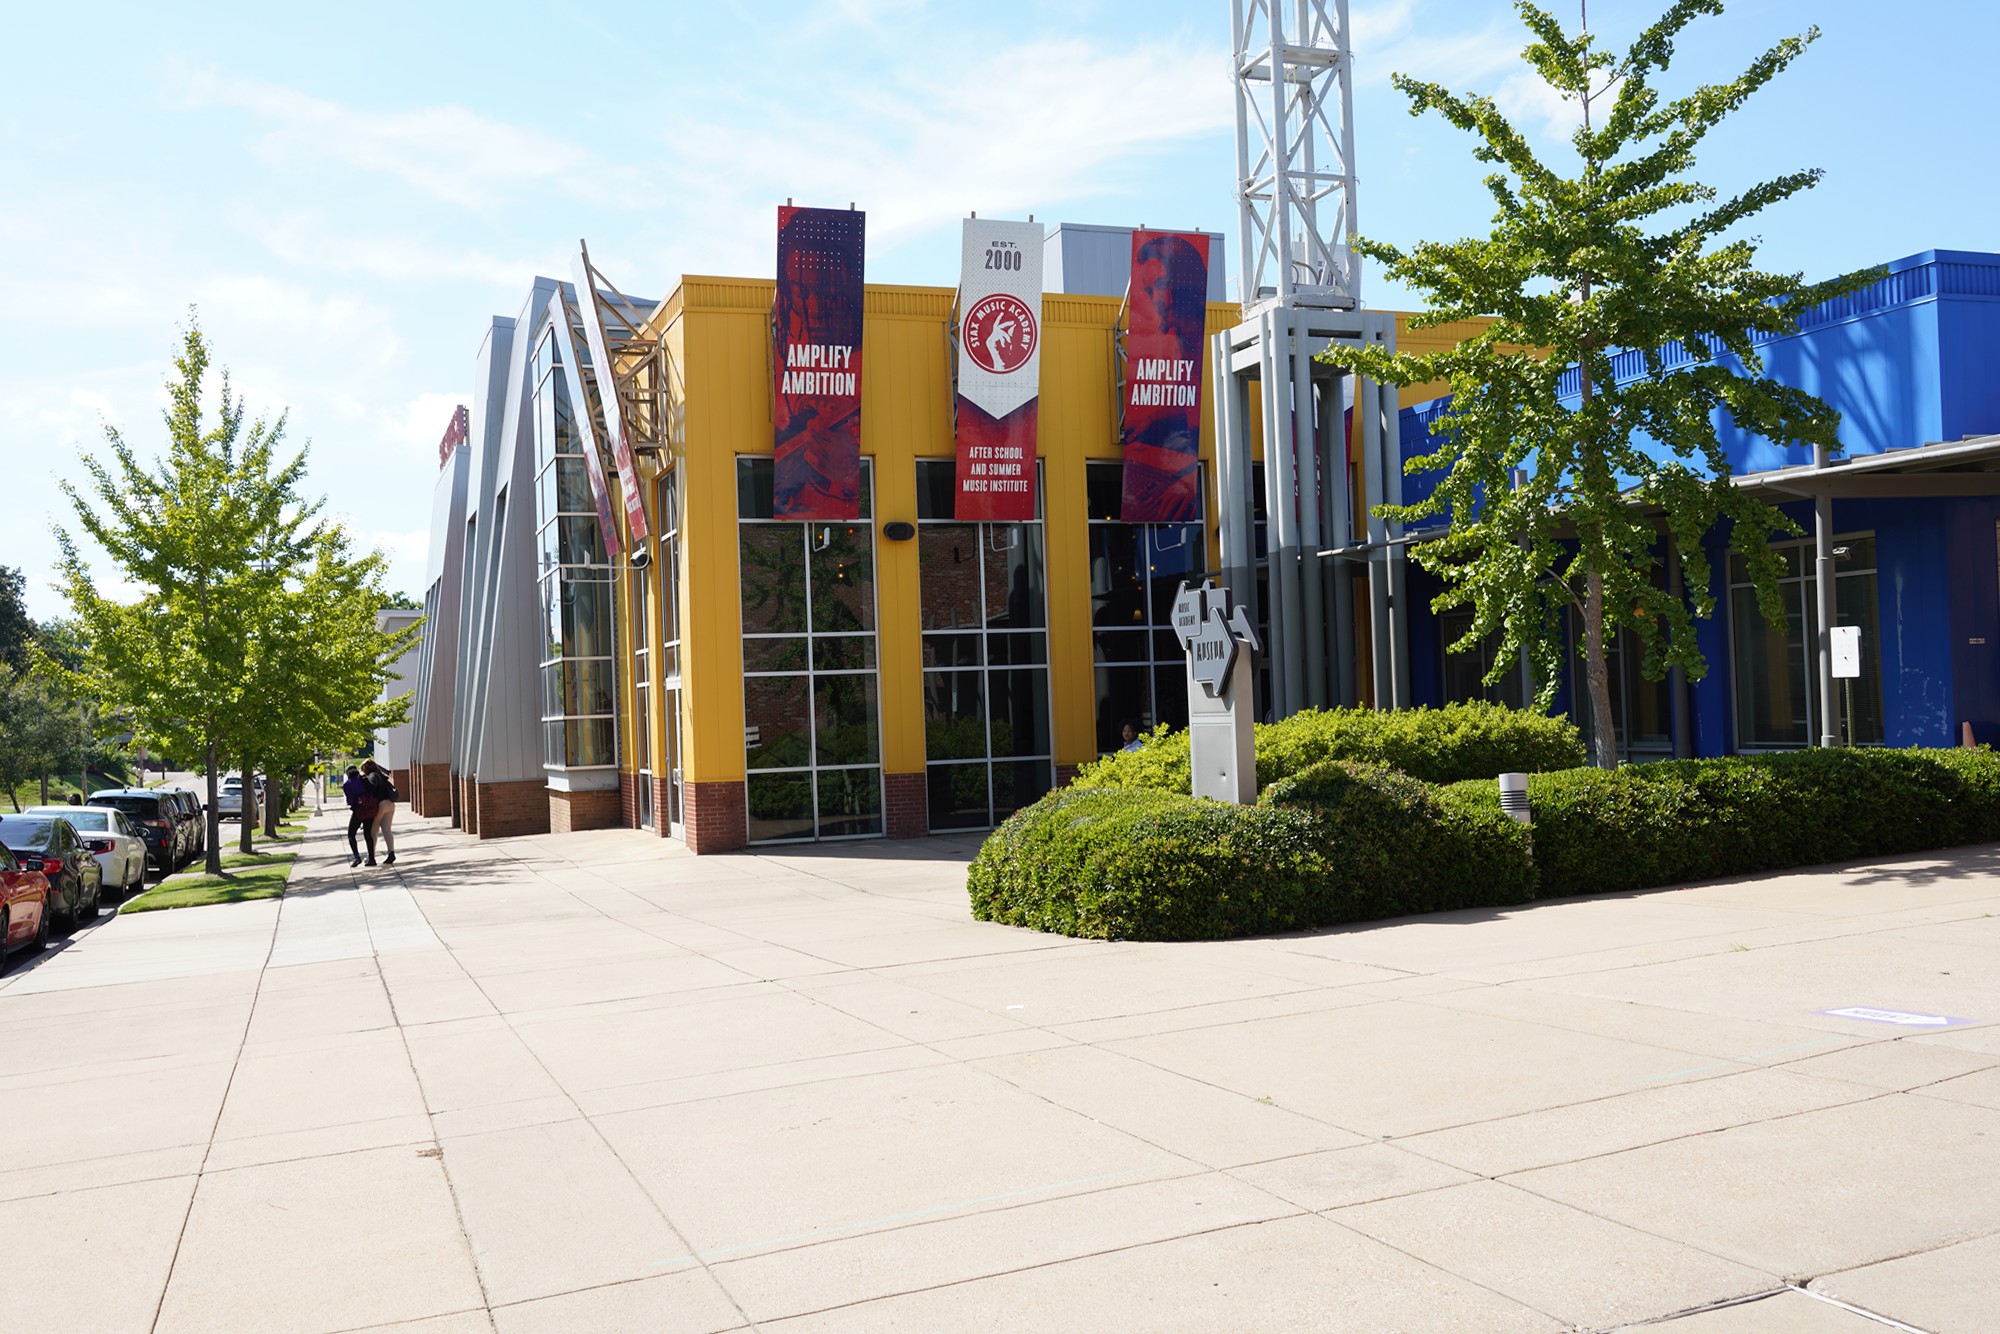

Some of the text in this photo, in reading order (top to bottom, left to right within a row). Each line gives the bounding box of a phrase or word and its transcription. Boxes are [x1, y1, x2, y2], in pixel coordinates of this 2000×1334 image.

[985, 249, 1022, 271] 2000
[970, 301, 1031, 350] STAX MUSIC ACADEMY
[787, 344, 852, 369] AMPLIFY
[1136, 359, 1194, 381] AMPLIFY
[782, 371, 856, 396] AMBITION
[1131, 384, 1196, 407] AMBITION
[969, 446, 1023, 459] AFTER SCHOOL
[971, 463, 1021, 475] AND SUMMER
[963, 479, 1028, 492] MUSIC INSTITUTE
[1196, 640, 1225, 662] MUSEUM
